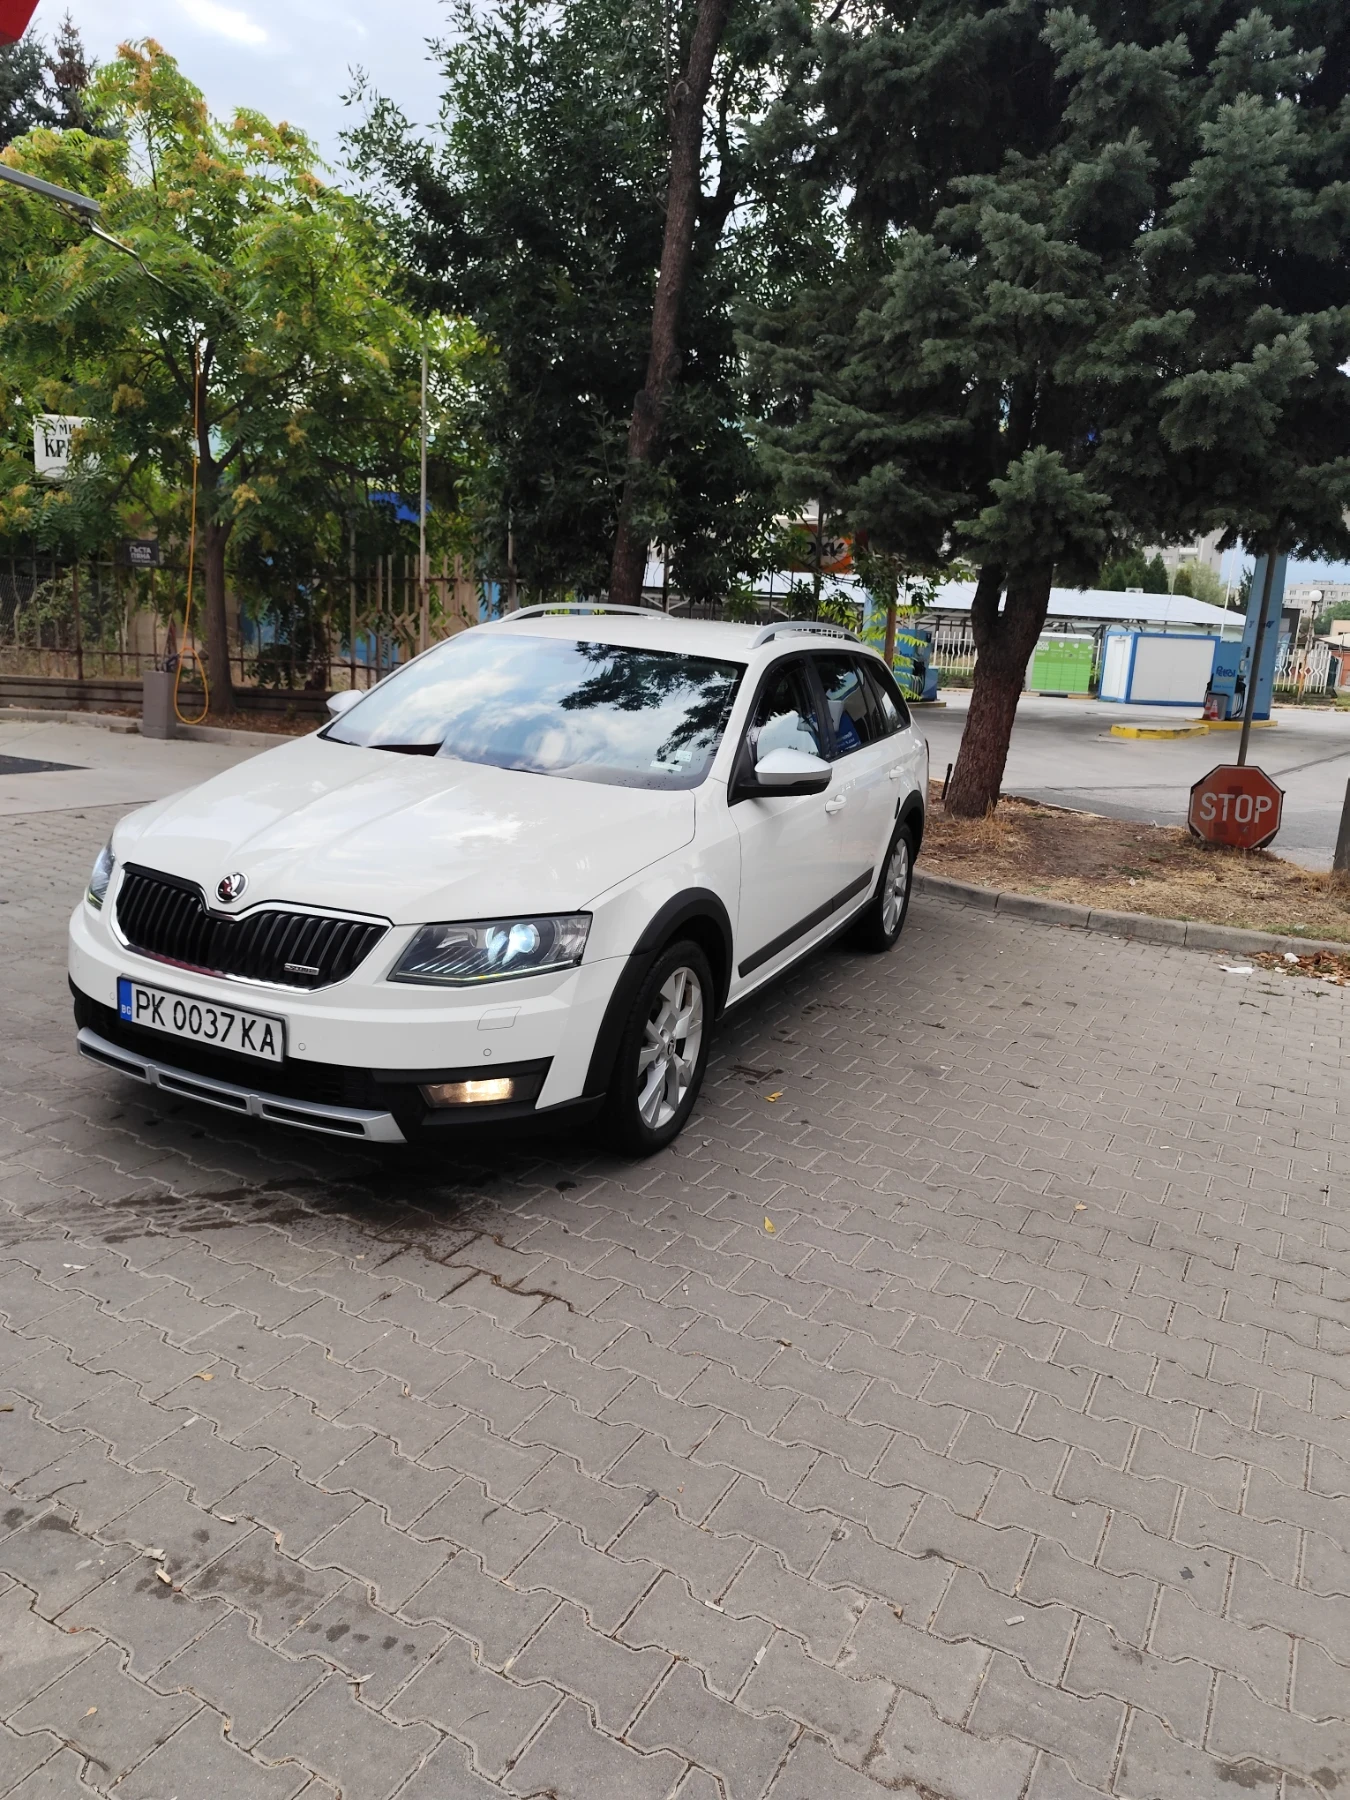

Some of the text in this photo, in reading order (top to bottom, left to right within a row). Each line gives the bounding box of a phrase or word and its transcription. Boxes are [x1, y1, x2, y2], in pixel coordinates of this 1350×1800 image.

[1200, 792, 1272, 823] STOP
[121, 1005, 132, 1015] BG
[136, 989, 275, 1056] PK 0037 KA
